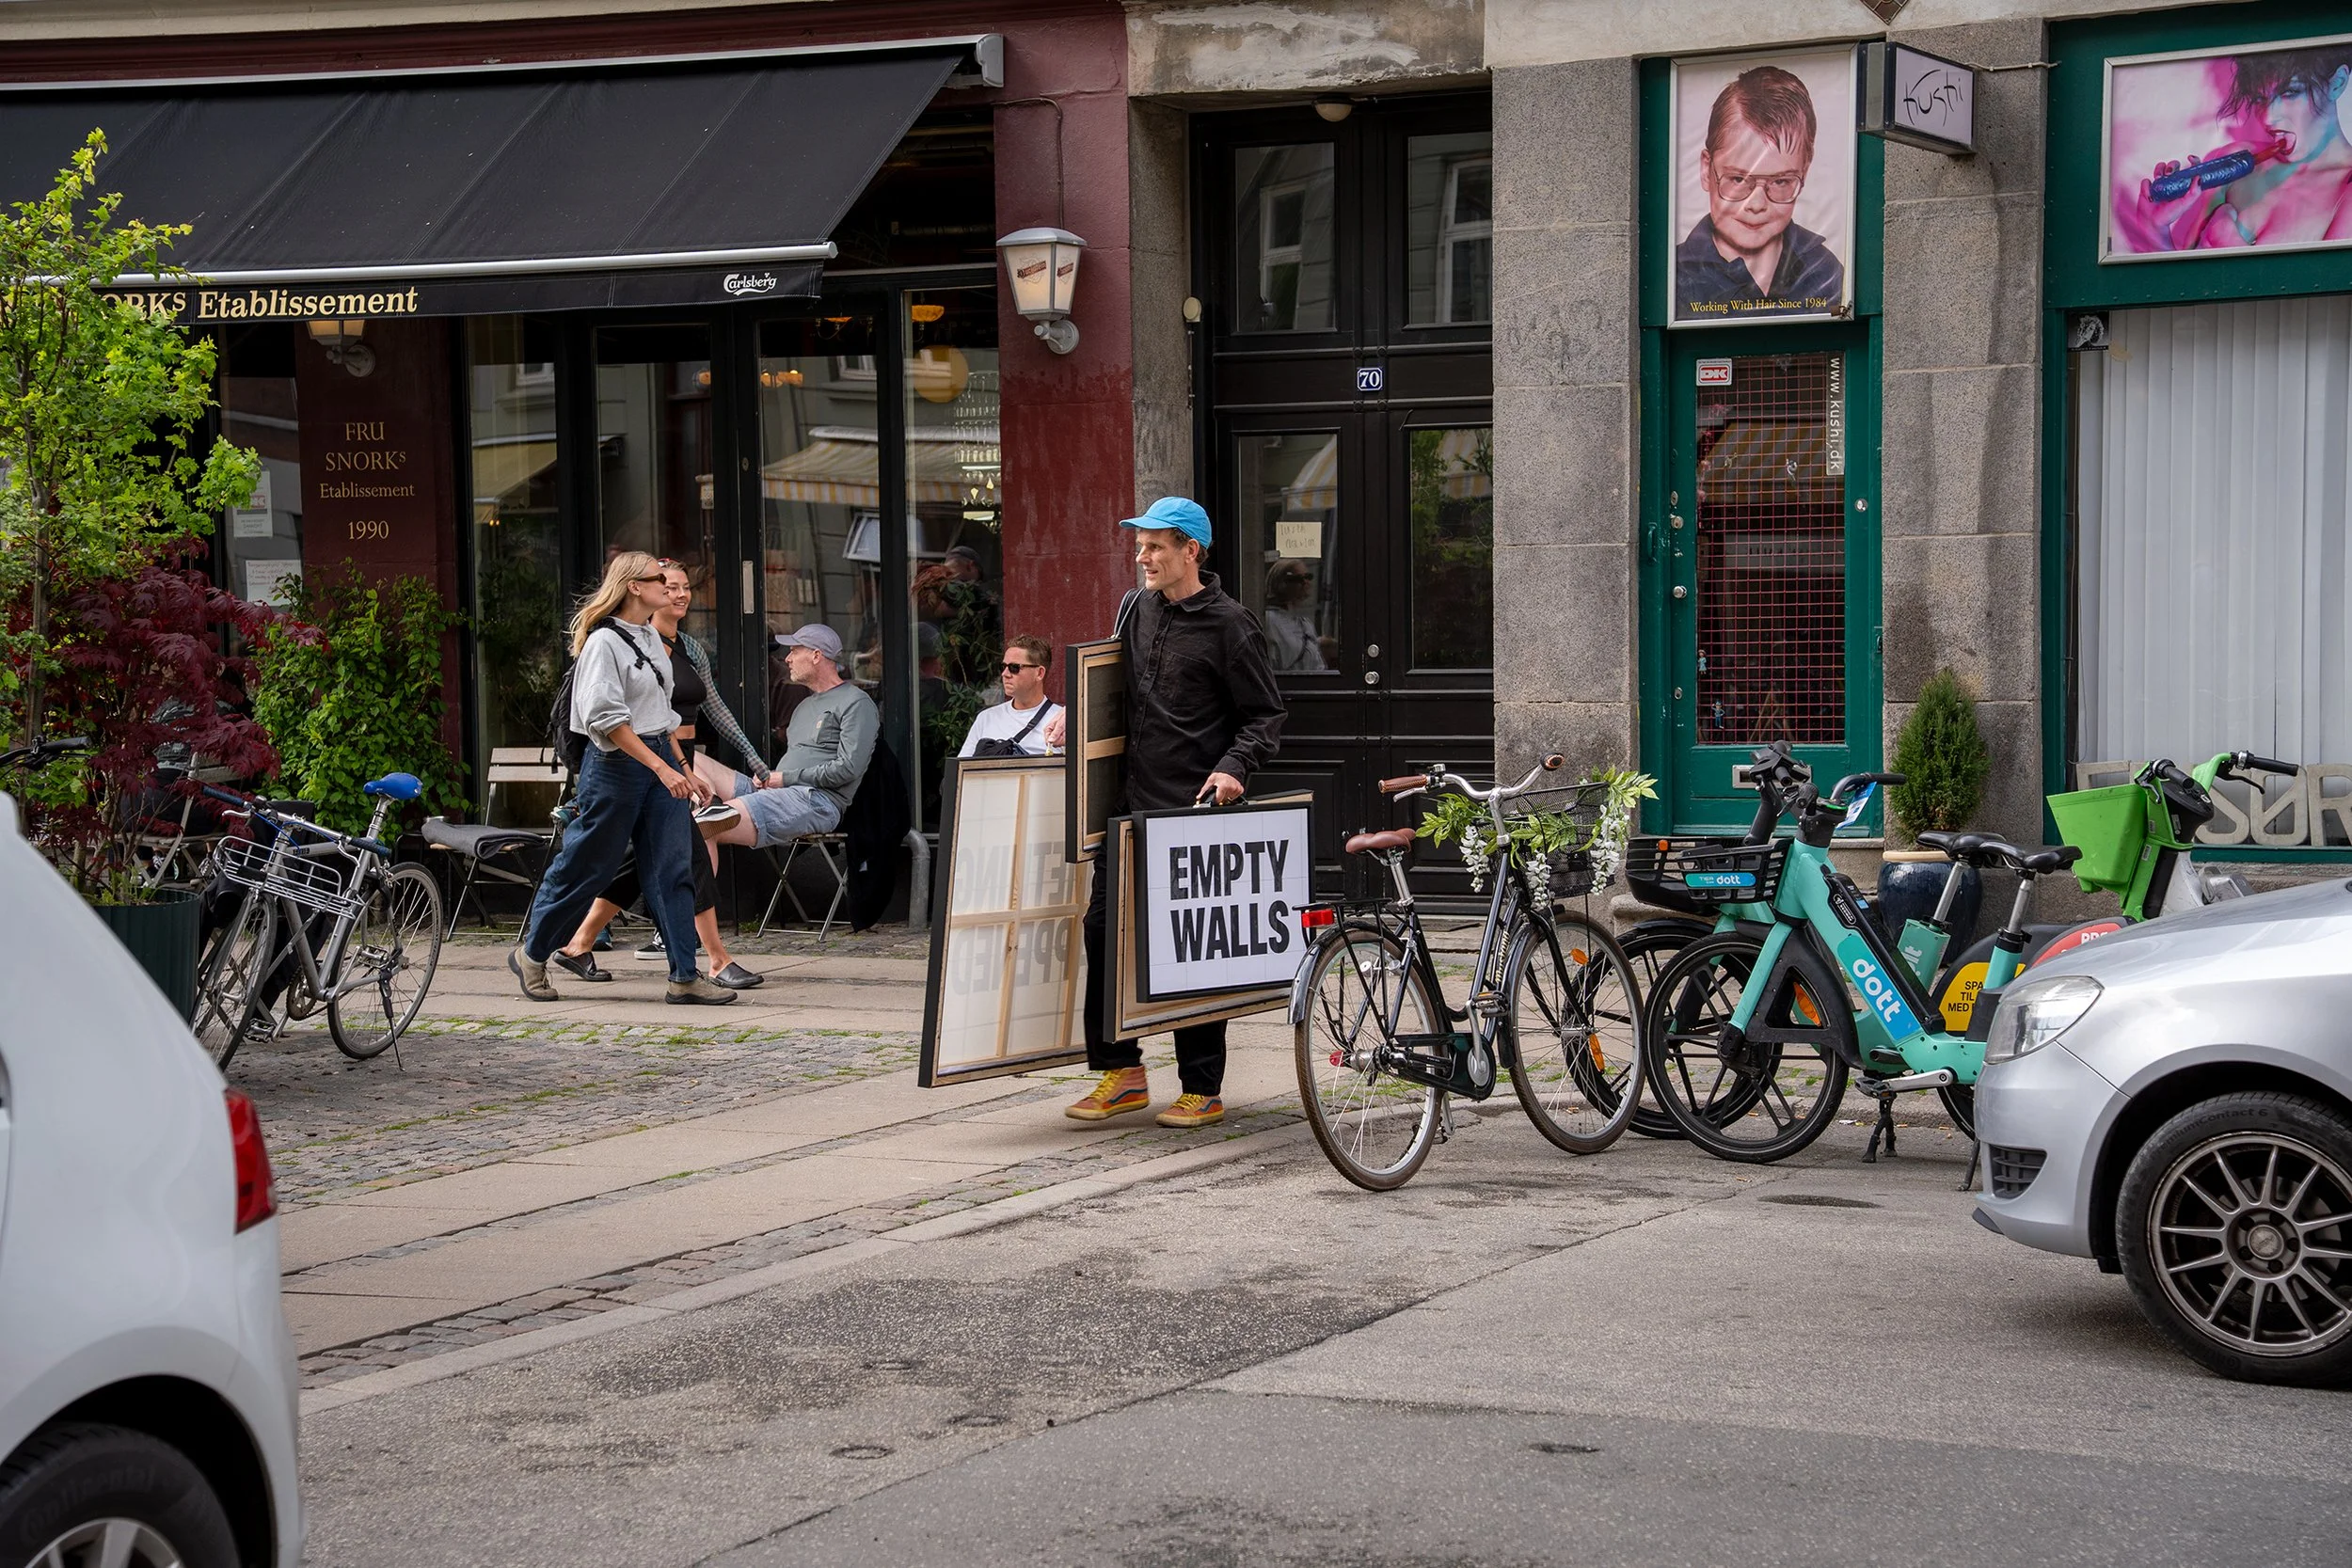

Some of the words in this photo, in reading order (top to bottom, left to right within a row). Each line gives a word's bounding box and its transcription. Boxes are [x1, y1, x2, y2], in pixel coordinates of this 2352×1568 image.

[723, 273, 778, 296] Carlsberg
[198, 286, 419, 319] Etablissement
[1691, 301, 1728, 314] Working
[1730, 299, 1753, 311] With
[1756, 298, 1776, 309] Hair
[1777, 297, 1802, 309] Since
[1804, 297, 1827, 309] 1984
[1359, 371, 1380, 388] 70
[1699, 367, 1728, 381] DK
[1830, 357, 1843, 469] www.kushi.dk
[345, 421, 385, 441] FRU
[320, 482, 415, 499] Etablissement
[347, 520, 389, 540] 1990
[1169, 839, 1289, 900] EMPTY
[1716, 875, 1741, 885] dott
[1169, 900, 1290, 963] WALLS
[1852, 958, 1901, 1023] dott
[1965, 981, 1983, 990] SPA
[1961, 991, 1975, 1001] TIL
[1948, 1003, 1969, 1012] MED
[2258, 1108, 2268, 1117] 6
